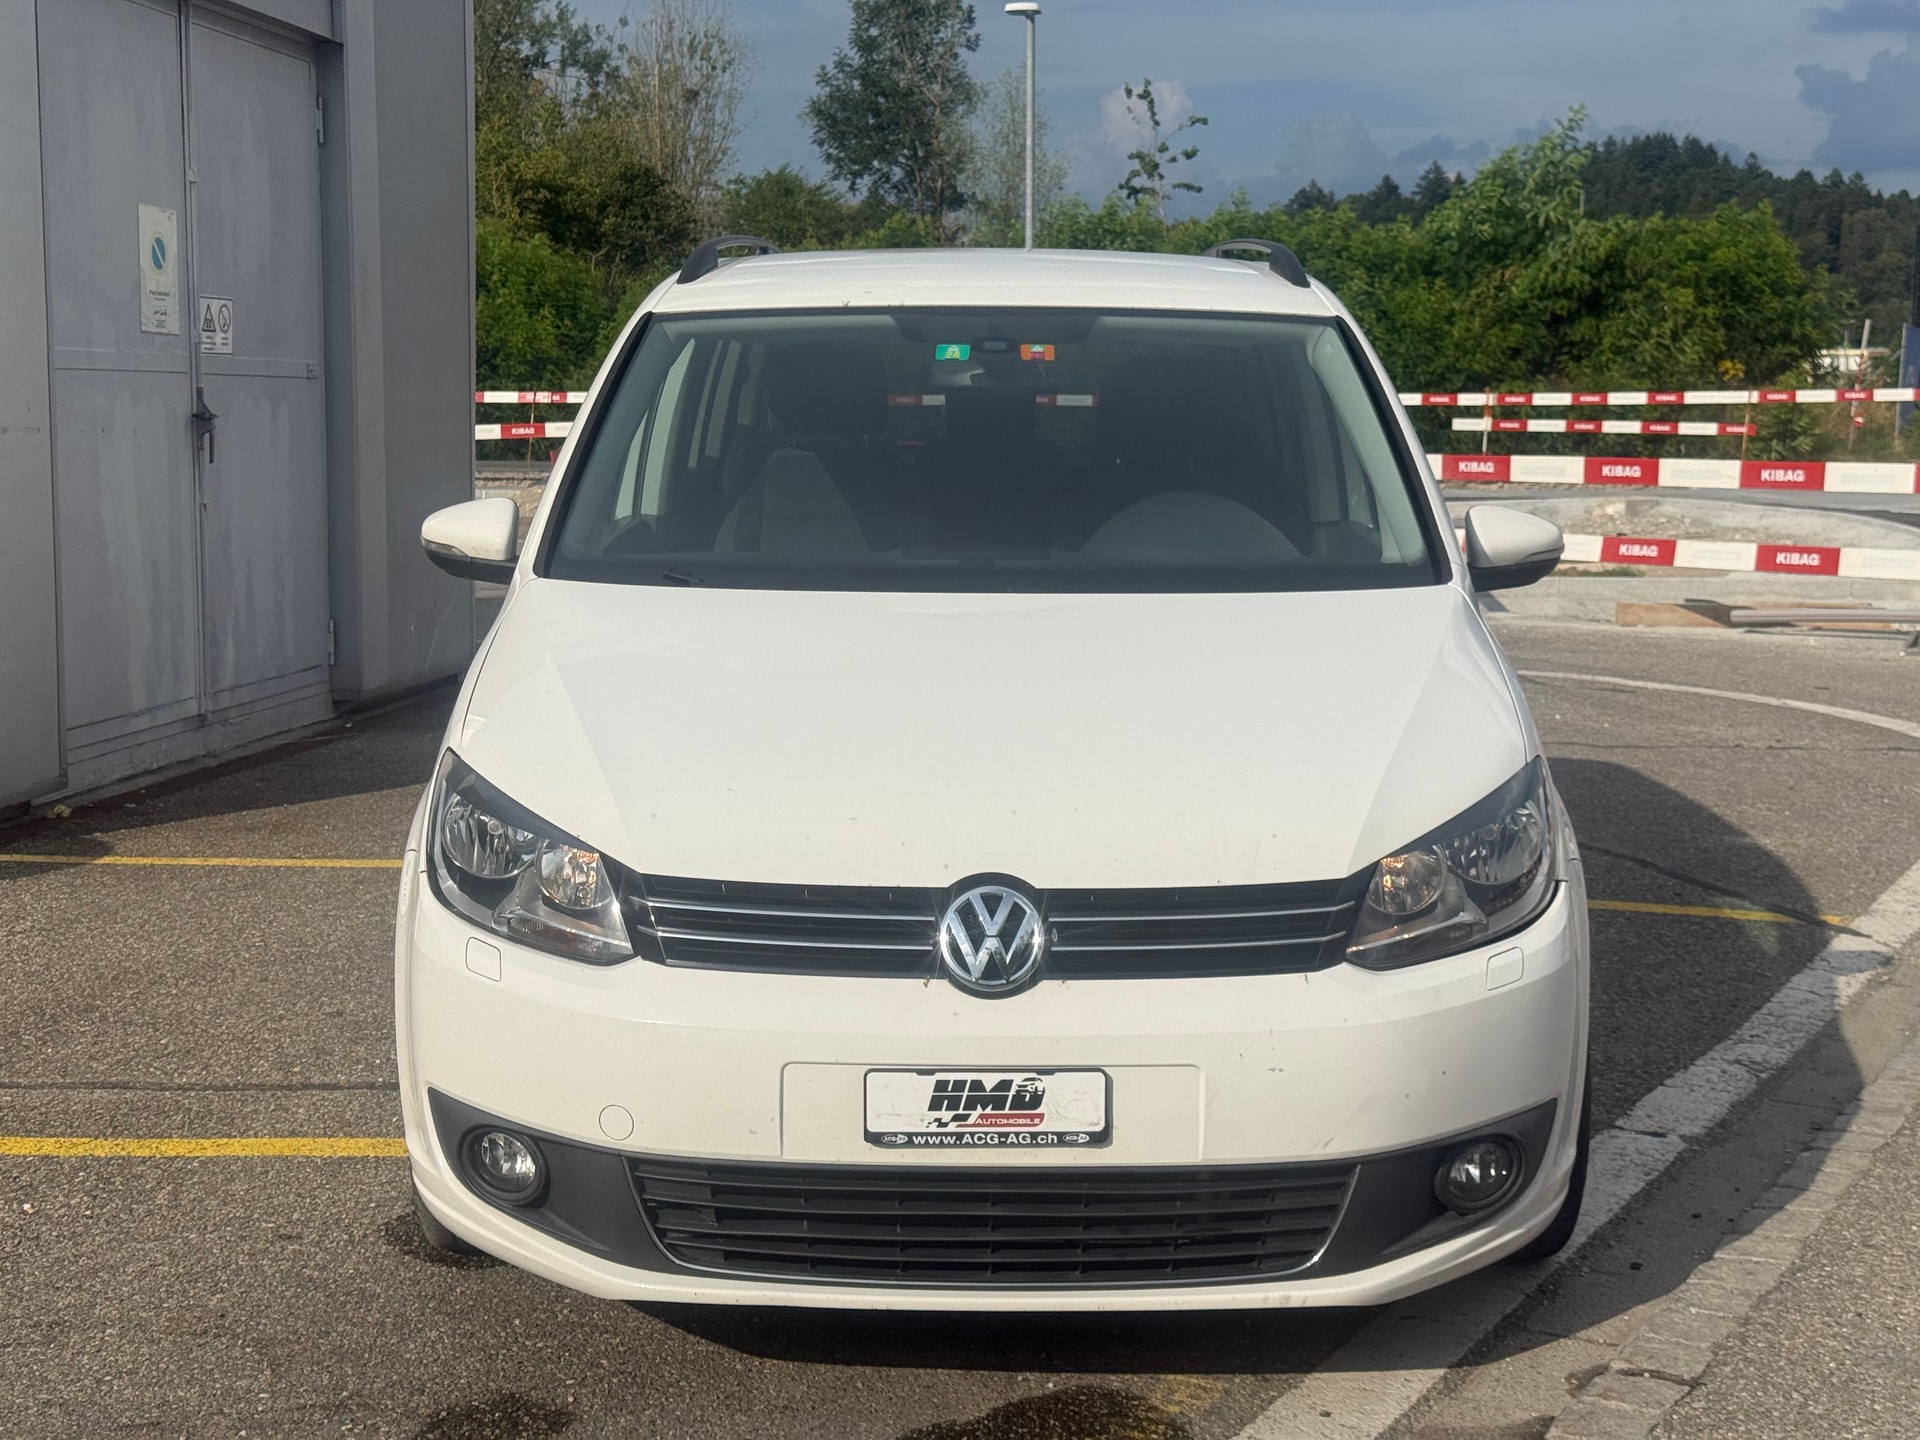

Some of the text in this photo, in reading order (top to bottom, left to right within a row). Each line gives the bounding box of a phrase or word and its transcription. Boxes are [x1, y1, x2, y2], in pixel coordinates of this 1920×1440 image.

[1458, 461, 1495, 473] KIBAG
[1601, 464, 1642, 478] KIBAG
[1760, 468, 1806, 482] KIBAG
[1618, 543, 1659, 557] KIBAG
[1775, 551, 1821, 566] KIBAG
[975, 1117, 1041, 1125] AUTOMOBILE
[912, 1133, 1058, 1145] www.ACG-AG.ch
